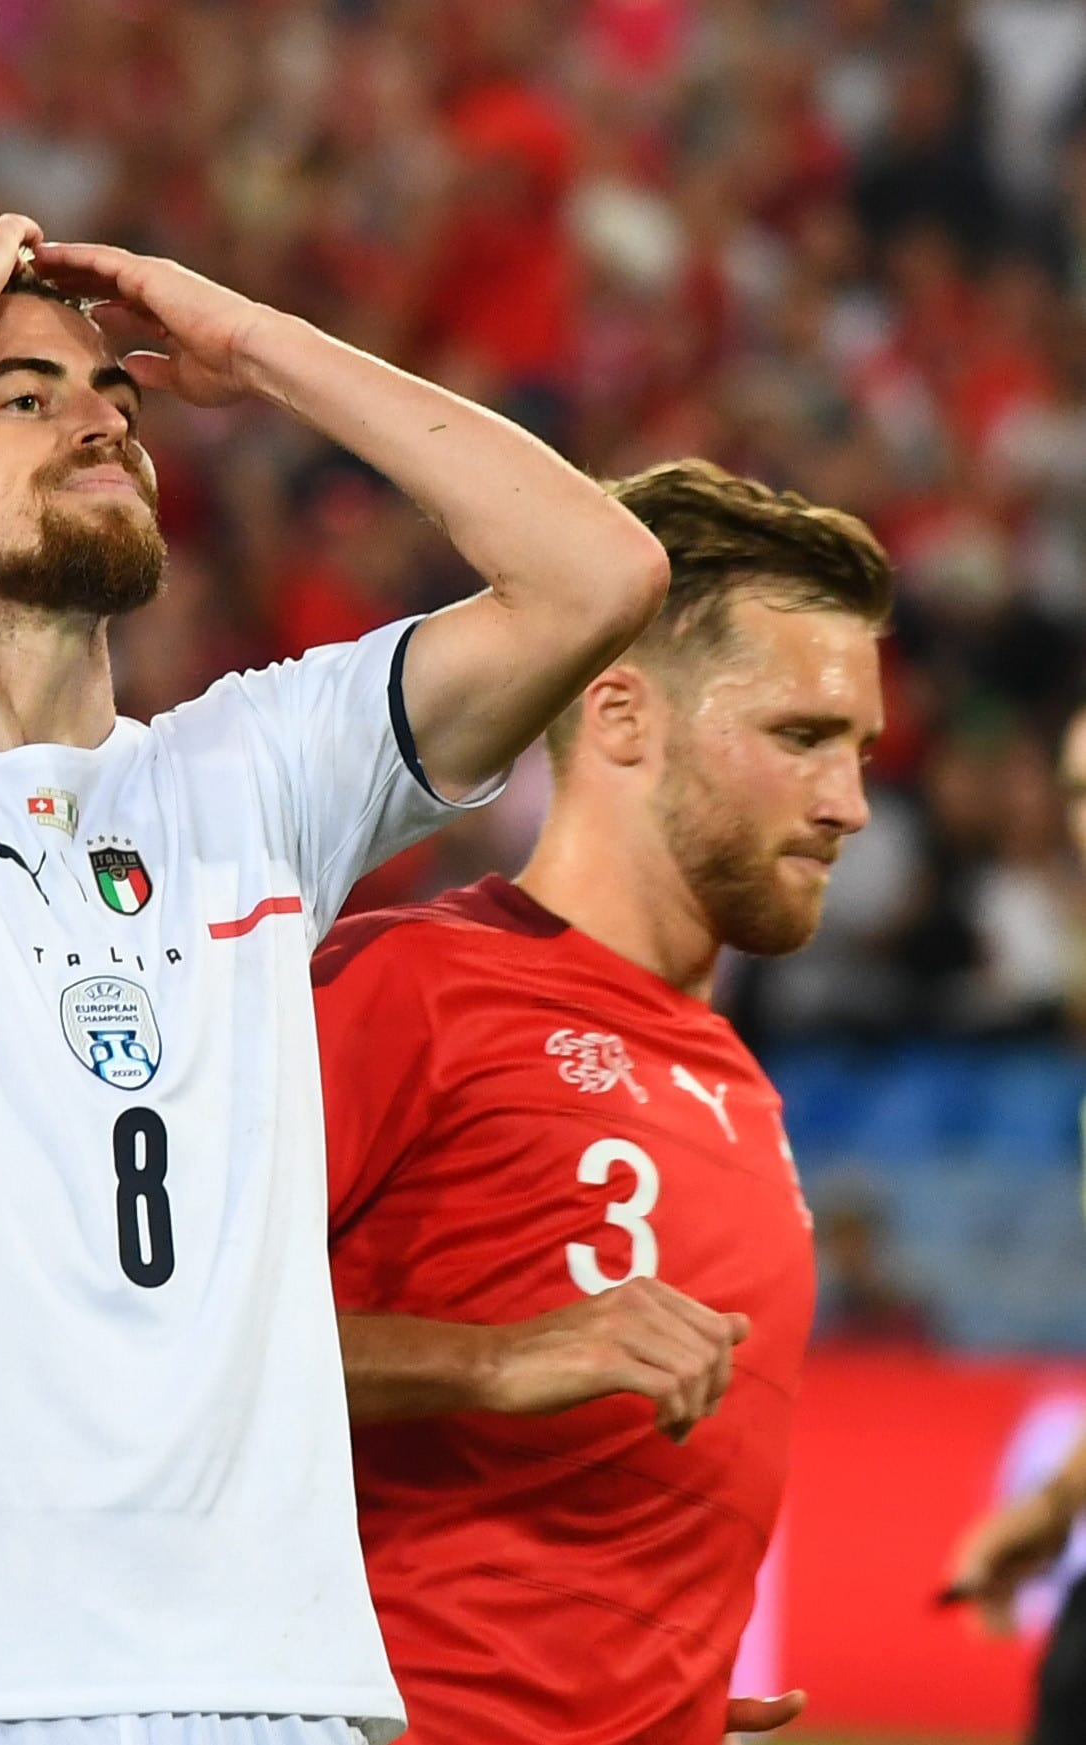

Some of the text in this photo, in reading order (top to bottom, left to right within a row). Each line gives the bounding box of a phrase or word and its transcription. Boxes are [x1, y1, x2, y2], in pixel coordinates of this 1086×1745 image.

[93, 853, 137, 866] ITALIA
[33, 946, 183, 972] TALIA
[75, 1004, 137, 1014] EUROPEAN
[77, 1014, 139, 1023] CHAMPIONS
[111, 1069, 142, 1078] 2020
[113, 1106, 175, 1289] 8
[566, 1138, 659, 1295] 3
